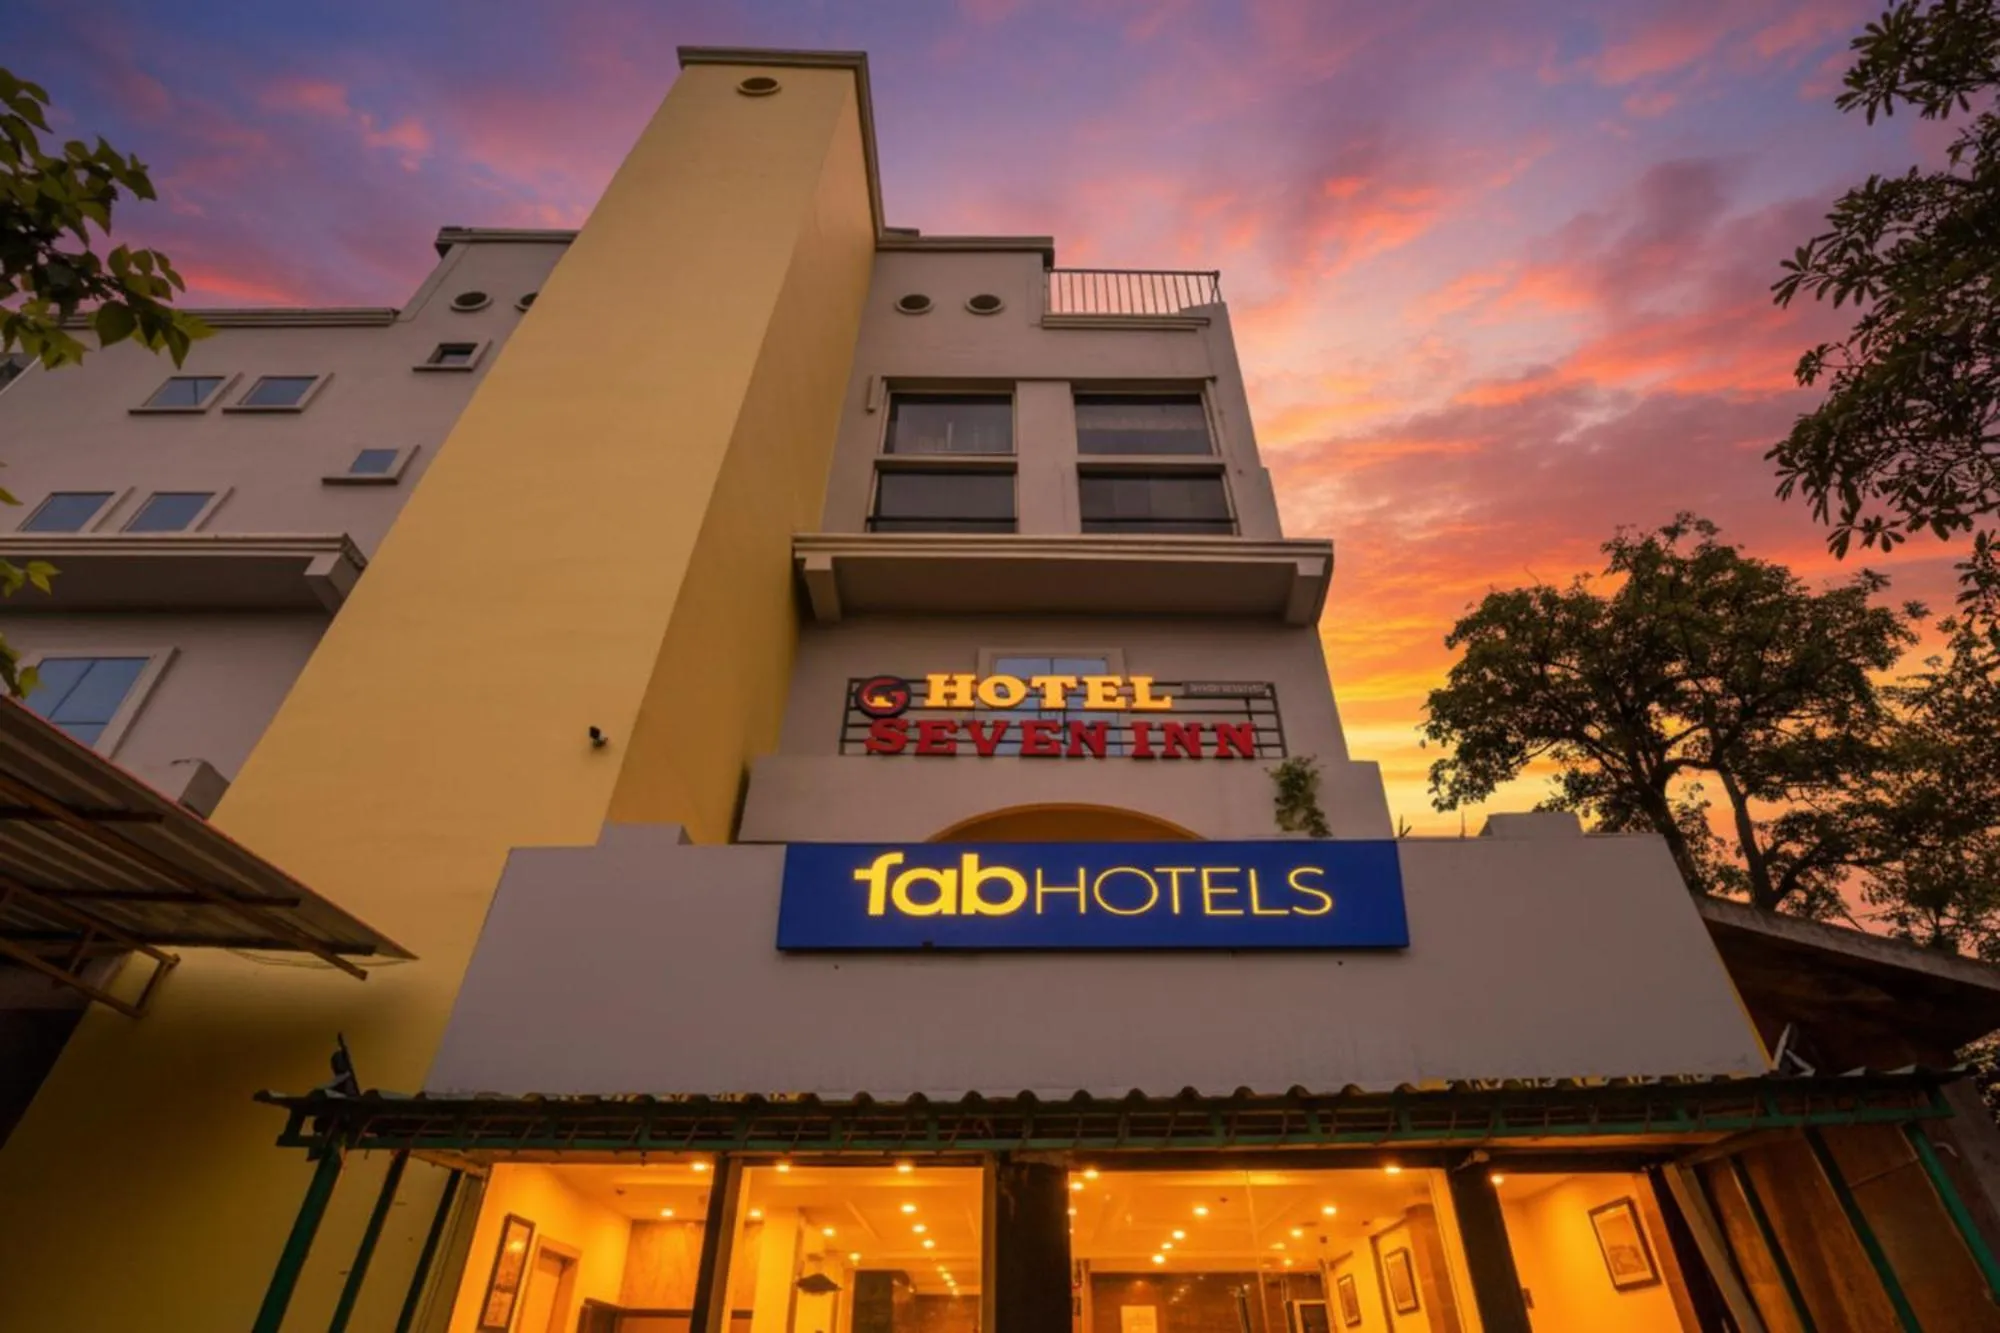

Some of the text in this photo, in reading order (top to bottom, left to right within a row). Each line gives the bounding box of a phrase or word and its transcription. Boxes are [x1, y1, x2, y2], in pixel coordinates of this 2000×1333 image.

[925, 674, 1172, 709] HOTEL
[864, 720, 1257, 760] SEVEN INN
